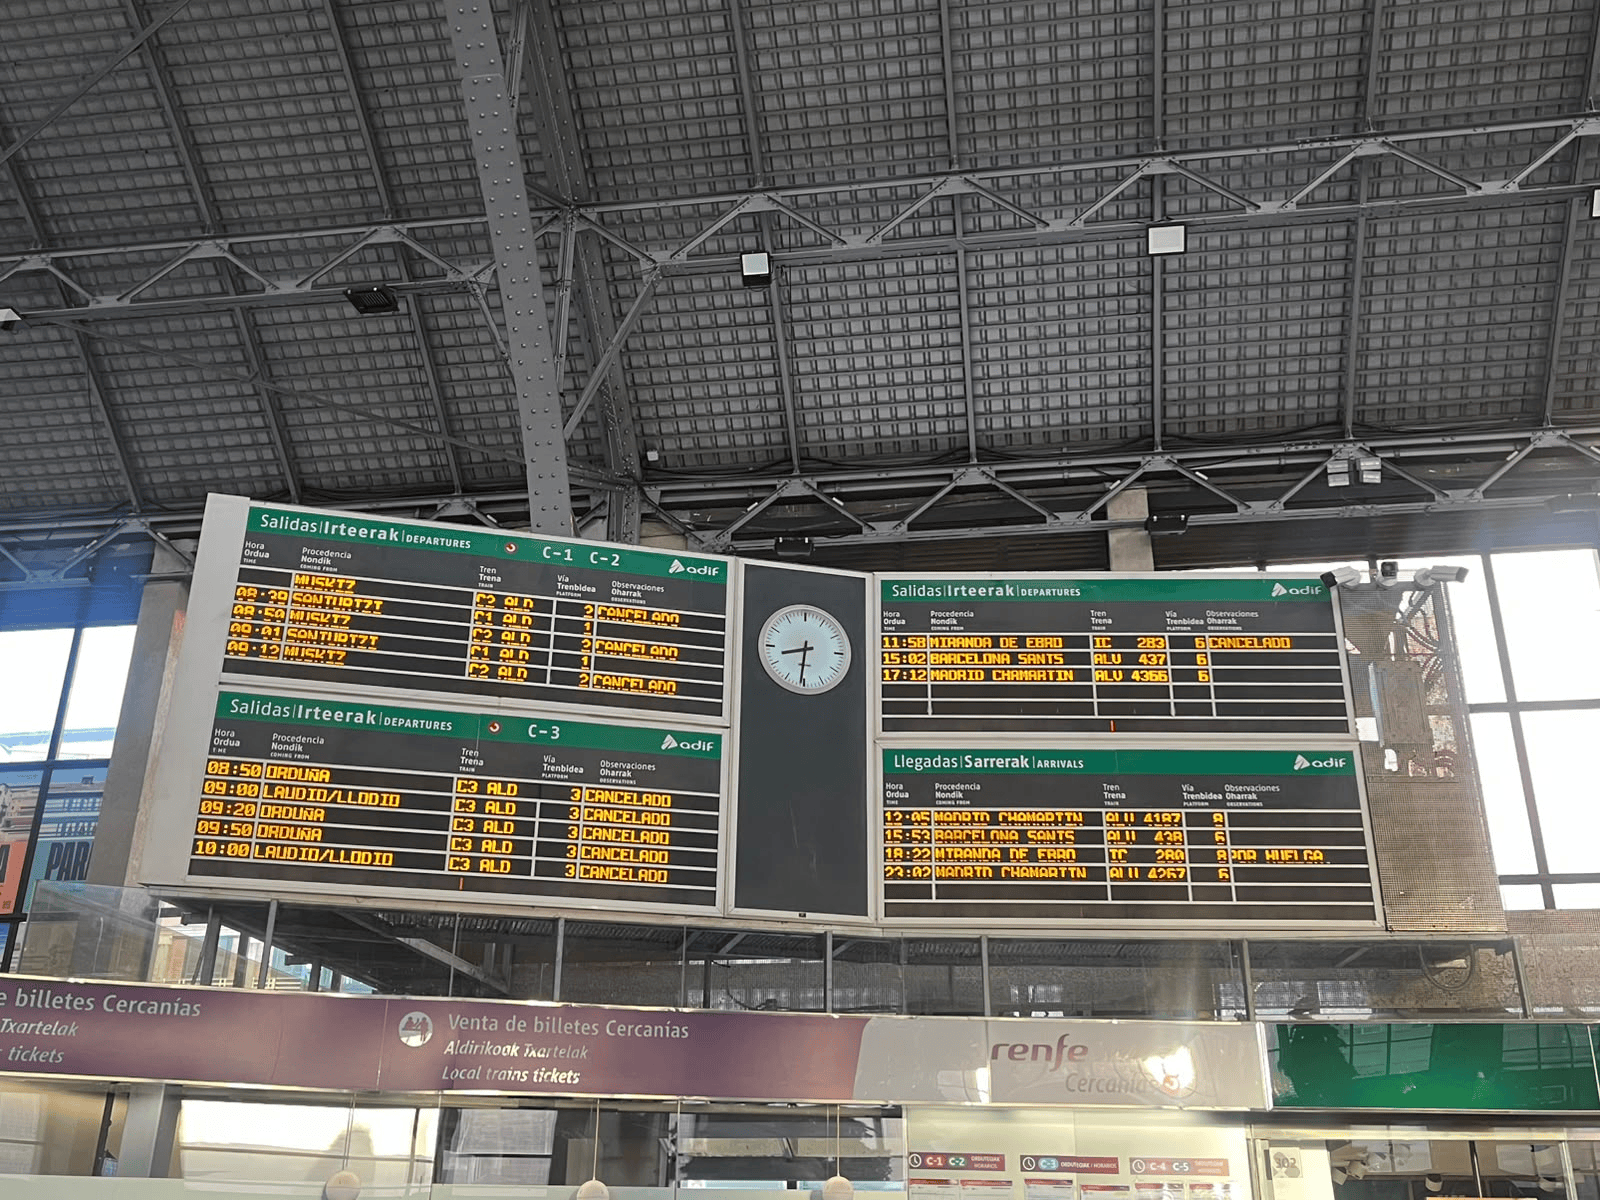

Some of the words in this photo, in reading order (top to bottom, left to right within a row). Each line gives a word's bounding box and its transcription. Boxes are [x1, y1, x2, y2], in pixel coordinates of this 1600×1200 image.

[261, 514, 317, 532] Salidas
[324, 521, 398, 541] Irteerak
[406, 535, 471, 548] DEPARTURES
[245, 541, 264, 549] Hora
[245, 549, 269, 558] Ordua
[301, 547, 352, 559] Procedencia
[543, 546, 573, 561] C-1
[590, 552, 620, 566] C-2
[301, 555, 331, 564] Nondik
[687, 566, 719, 576] adif
[479, 574, 501, 582] Trena
[557, 583, 596, 592] Trenbidea
[611, 581, 664, 593] Observaciones
[611, 588, 642, 597] Oharrak
[892, 585, 941, 597] Salidas
[948, 586, 1014, 596] Irteerak
[1289, 586, 1321, 595] adif
[884, 637, 926, 648] 11:58
[930, 637, 991, 648] MIRANDA
[1000, 638, 1017, 648] DE
[1026, 638, 1062, 648] EBRO
[1094, 638, 1111, 648] IC
[1137, 638, 1164, 648] 283
[1195, 638, 1205, 648] 6
[1209, 638, 1290, 648] CANCELADO
[884, 653, 926, 664] 15:02
[930, 653, 1010, 664] BARCELONA
[1018, 654, 1063, 664] SANTS
[1094, 654, 1121, 664] ALV
[1139, 654, 1165, 665] 437
[1197, 654, 1206, 665] 6
[884, 670, 926, 680] 17:12
[930, 670, 984, 680] MADRID
[992, 670, 1073, 680] CHAMARTIN
[1095, 670, 1123, 681] ALV
[1132, 670, 1168, 681] 4366
[1198, 671, 1208, 681] 6
[230, 699, 290, 717] Salidas
[298, 705, 376, 724] Irteerak
[384, 717, 452, 731] DEPARTURES
[215, 728, 235, 737] Hora
[528, 724, 559, 739] C-3
[214, 738, 240, 747] Ordua
[273, 733, 324, 744] Procedencia
[272, 742, 303, 751] Nondik
[680, 740, 714, 751] adif
[462, 748, 478, 756] Tren
[461, 756, 484, 766] Trena
[544, 755, 555, 763] Vía
[895, 755, 957, 771] Llegadas
[965, 755, 1029, 768] Sarrerak
[1037, 760, 1083, 768] ARRIVALS
[1312, 758, 1346, 767] adif
[543, 764, 583, 773] Trenbidea
[600, 760, 656, 771] Observaciones
[600, 768, 632, 778] Oharrak
[208, 761, 261, 777] 08:50
[266, 766, 330, 783] ORDUÑA
[457, 780, 478, 793] C3
[487, 783, 517, 795] ALD
[571, 789, 581, 801] 3
[584, 790, 671, 807] CANCELADO
[1225, 784, 1280, 792] Observaciones
[204, 781, 258, 797] 09:00
[262, 785, 400, 808] LAUDIO/LLODIO
[455, 799, 476, 812] C3
[485, 801, 515, 815] ALD
[569, 807, 580, 819] 3
[584, 808, 670, 825] CANCELADO
[201, 800, 255, 816] 09:20
[260, 805, 324, 821] ORDUÑA
[453, 818, 474, 831] C3
[483, 820, 514, 834] ALD
[568, 826, 578, 839] 3
[583, 827, 669, 845] CANCELADO
[197, 821, 252, 836] 09:50
[257, 824, 322, 841] ORDUÑA
[451, 838, 472, 851] C3
[482, 840, 512, 853] ALD
[567, 845, 576, 857] 3
[581, 846, 668, 863] CANCELADO
[1027, 831, 1074, 845] SANTS
[45, 842, 94, 880] PAR
[195, 841, 249, 857] 10:00
[254, 845, 393, 866] LAUDIO/LLODIO
[449, 857, 470, 870] C3
[480, 859, 510, 873] ALD
[565, 864, 575, 877] 3
[580, 865, 667, 882] CANCELADO
[15, 989, 94, 1011] billetes
[103, 994, 201, 1017] Cercanías
[0, 1018, 78, 1037] Txartelak
[449, 1014, 498, 1032] Venta
[505, 1018, 527, 1033] de
[534, 1017, 599, 1036] billetes
[606, 1020, 689, 1038] Cercanías
[8, 1046, 64, 1063] tickets
[444, 1041, 519, 1058] Aldirikoak
[523, 1043, 588, 1059] Txartelak
[991, 1034, 1089, 1072] renfe
[442, 1066, 480, 1080] Local
[486, 1068, 528, 1082] trains
[533, 1068, 580, 1084] tickets
[926, 1157, 943, 1165] C-1
[949, 1158, 965, 1166] C-2
[1150, 1162, 1166, 1170] C-4
[1172, 1162, 1189, 1171] C-5
